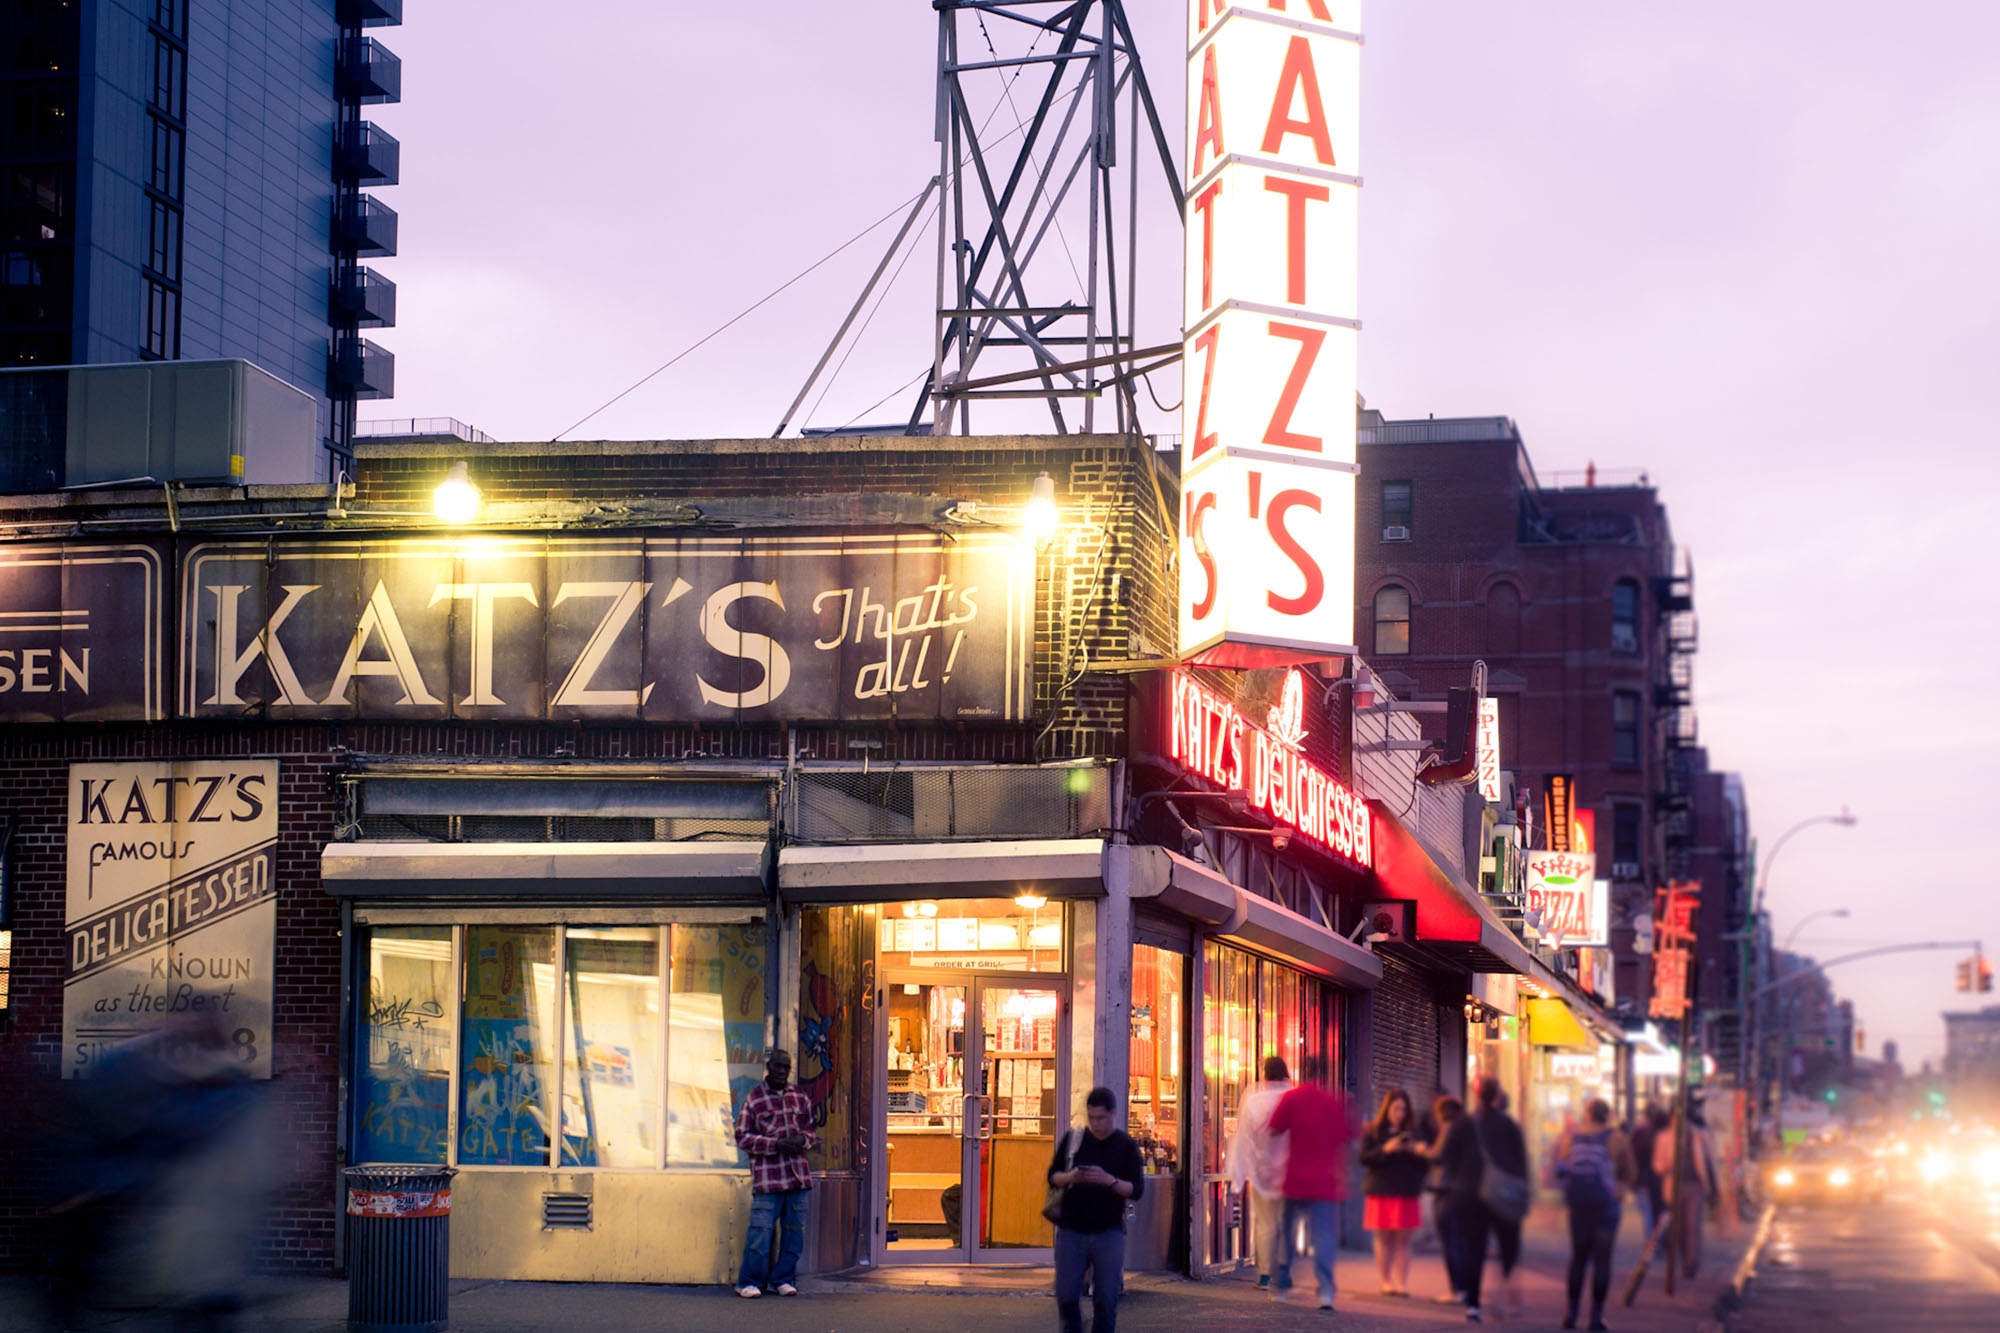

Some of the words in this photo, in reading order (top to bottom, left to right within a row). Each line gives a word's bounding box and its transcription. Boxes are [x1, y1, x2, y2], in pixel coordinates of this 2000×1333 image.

[1186, 0, 1227, 621] ATZ'S
[1248, 0, 1336, 617] ATZ'S
[202, 579, 791, 709] KATZ'S
[813, 573, 979, 650] That's
[1171, 671, 1243, 790] KATZ'S
[1481, 714, 1498, 799] PIZZA
[78, 773, 266, 824] KATZ'S
[72, 854, 269, 972] DELICATESSEN
[94, 996, 121, 1013] as
[127, 983, 167, 1013] the
[168, 983, 236, 1013] Best
[151, 956, 250, 979] KNOWN
[933, 960, 963, 969] ORDER
[965, 960, 976, 968] AT
